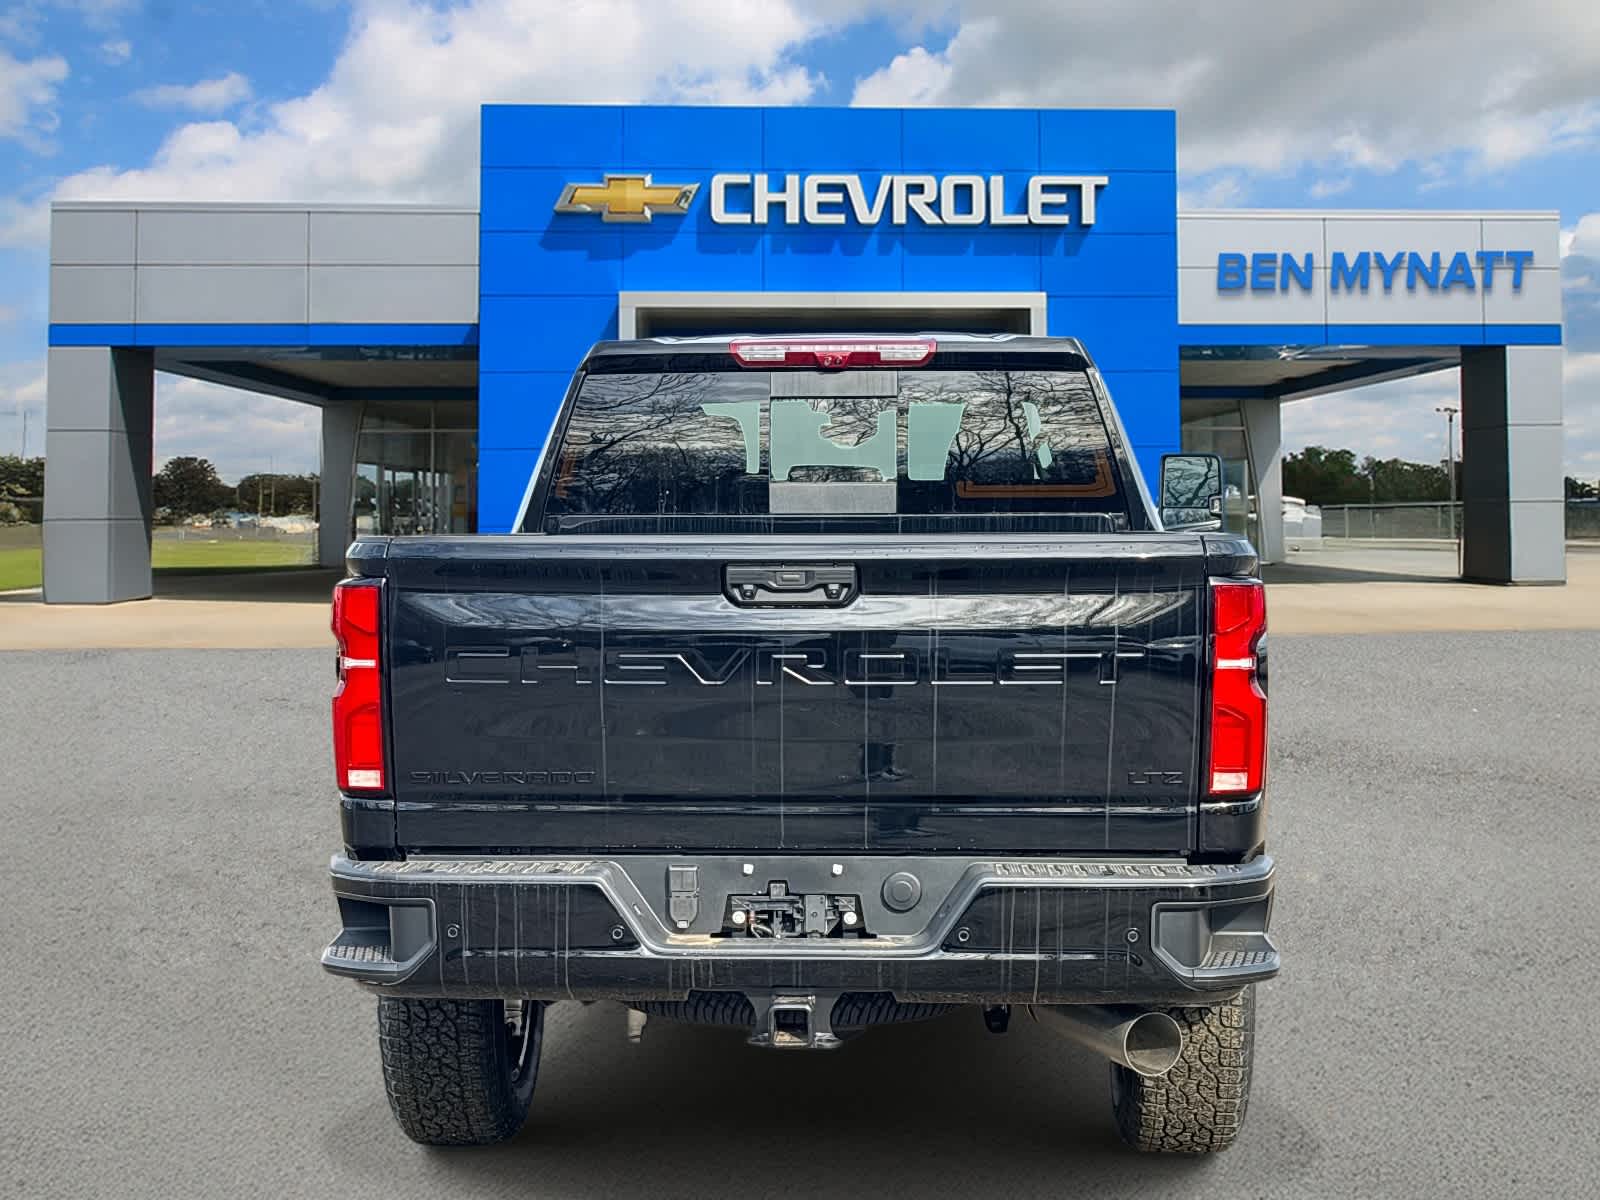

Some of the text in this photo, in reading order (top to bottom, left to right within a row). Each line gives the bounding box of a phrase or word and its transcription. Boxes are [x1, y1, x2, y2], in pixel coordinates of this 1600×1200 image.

[710, 173, 1109, 226] CHEVROLET
[1218, 251, 1534, 290] BEN MYNATT
[445, 648, 1145, 685] CHEVROLET
[409, 770, 597, 784] SILVERADO
[1127, 770, 1184, 785] LTZ
